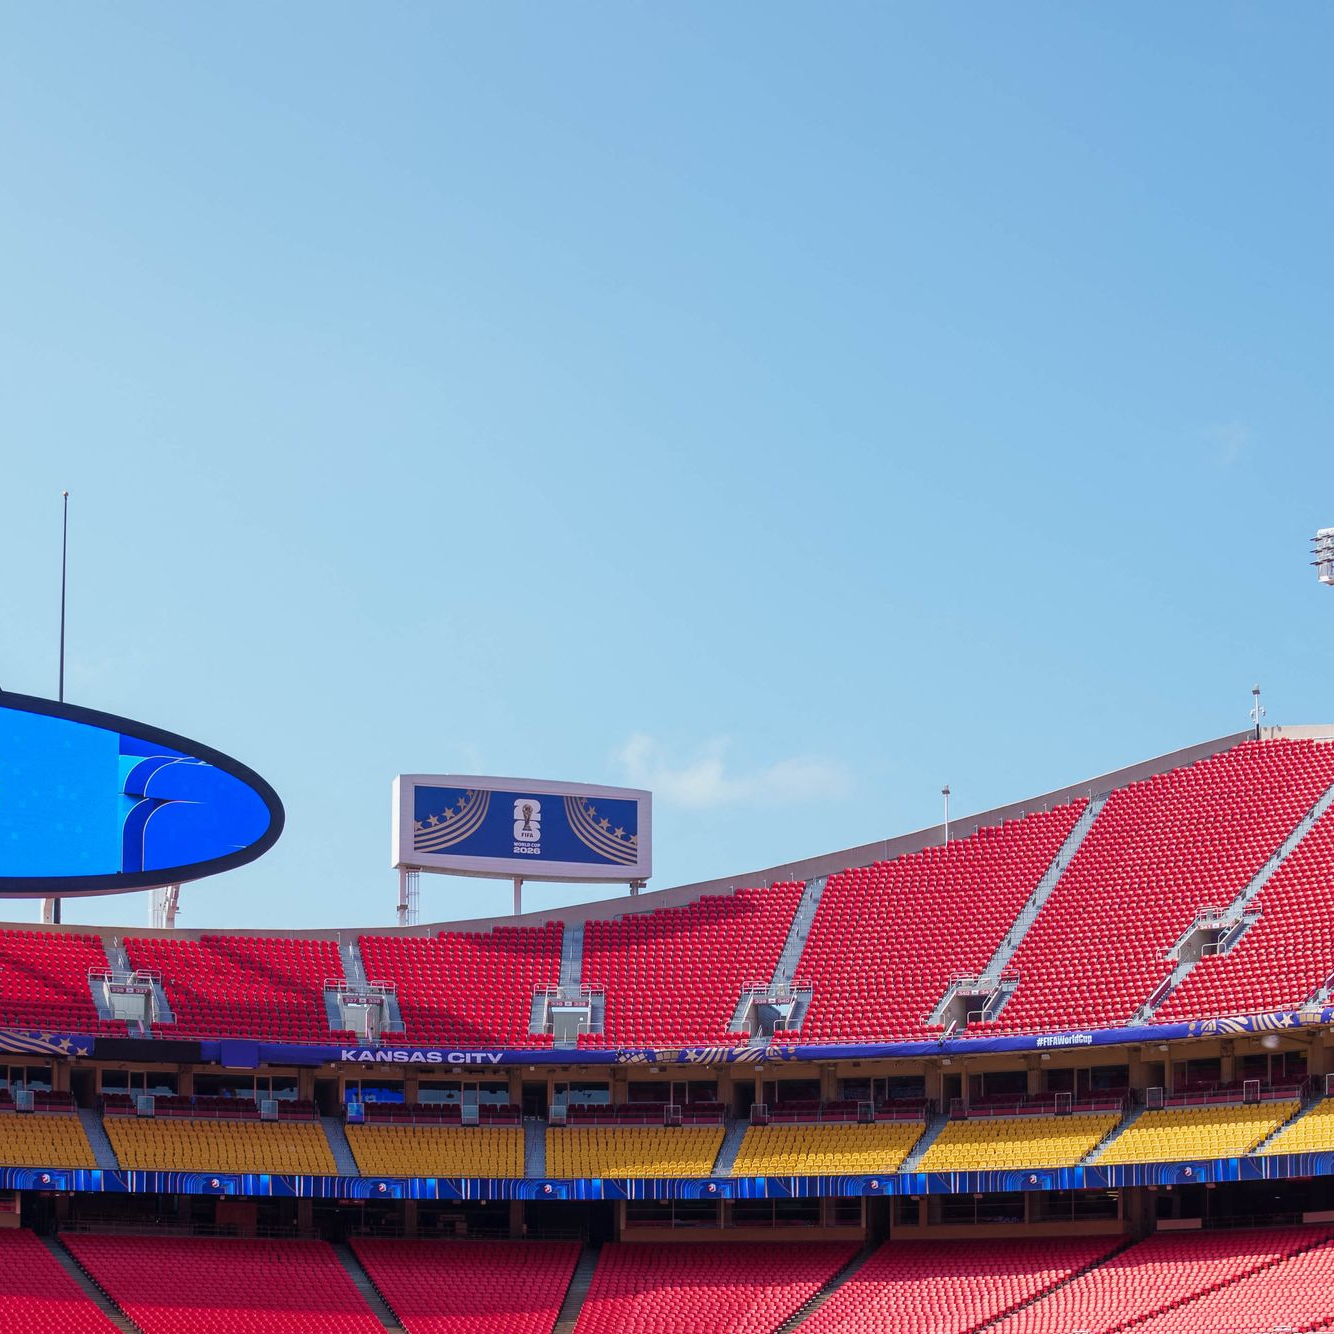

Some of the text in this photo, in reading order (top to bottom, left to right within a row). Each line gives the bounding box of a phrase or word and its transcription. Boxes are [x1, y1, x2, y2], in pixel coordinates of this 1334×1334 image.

[513, 847, 541, 855] 2026
[1036, 1034, 1093, 1048] #FIFAWorldCup
[341, 1048, 504, 1066] KANSAS CITY
